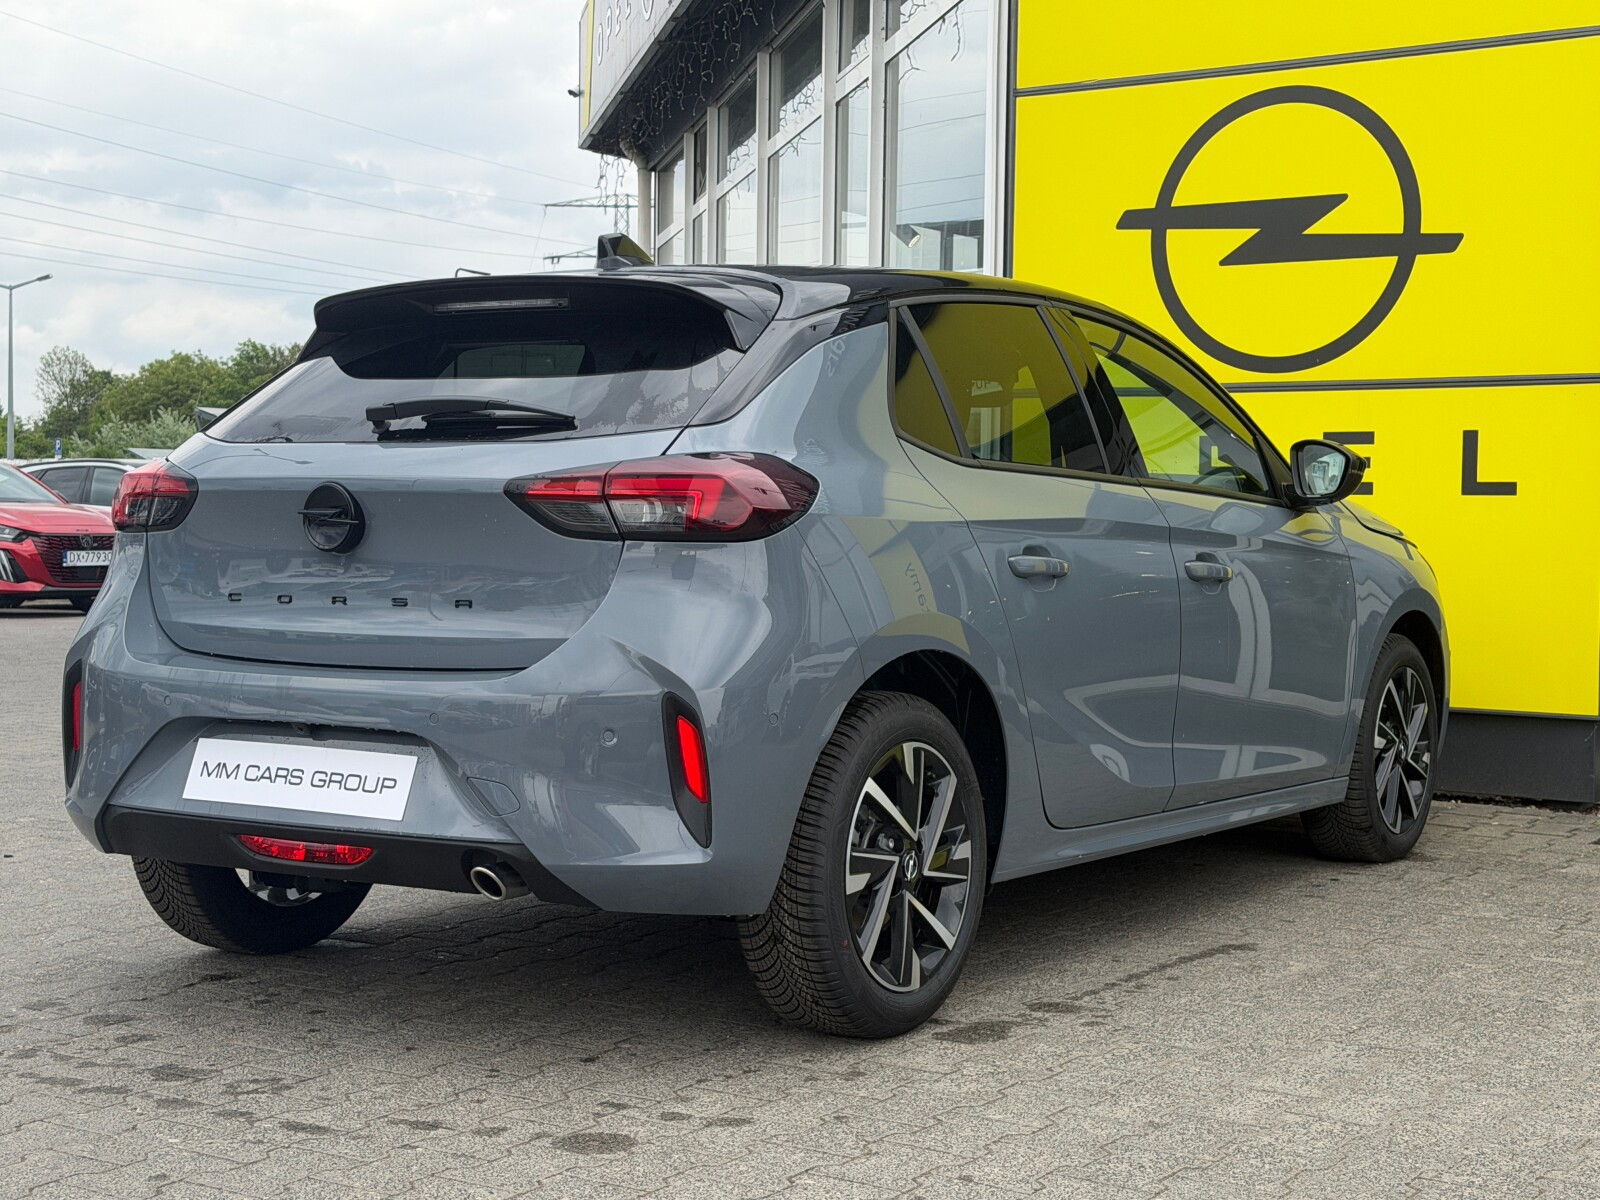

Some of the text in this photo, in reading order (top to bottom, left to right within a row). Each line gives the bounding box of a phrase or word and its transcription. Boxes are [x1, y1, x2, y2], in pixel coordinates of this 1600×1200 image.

[69, 552, 81, 563] DX
[228, 593, 472, 609] CORSA
[200, 761, 398, 795] MM CARS GROUP
